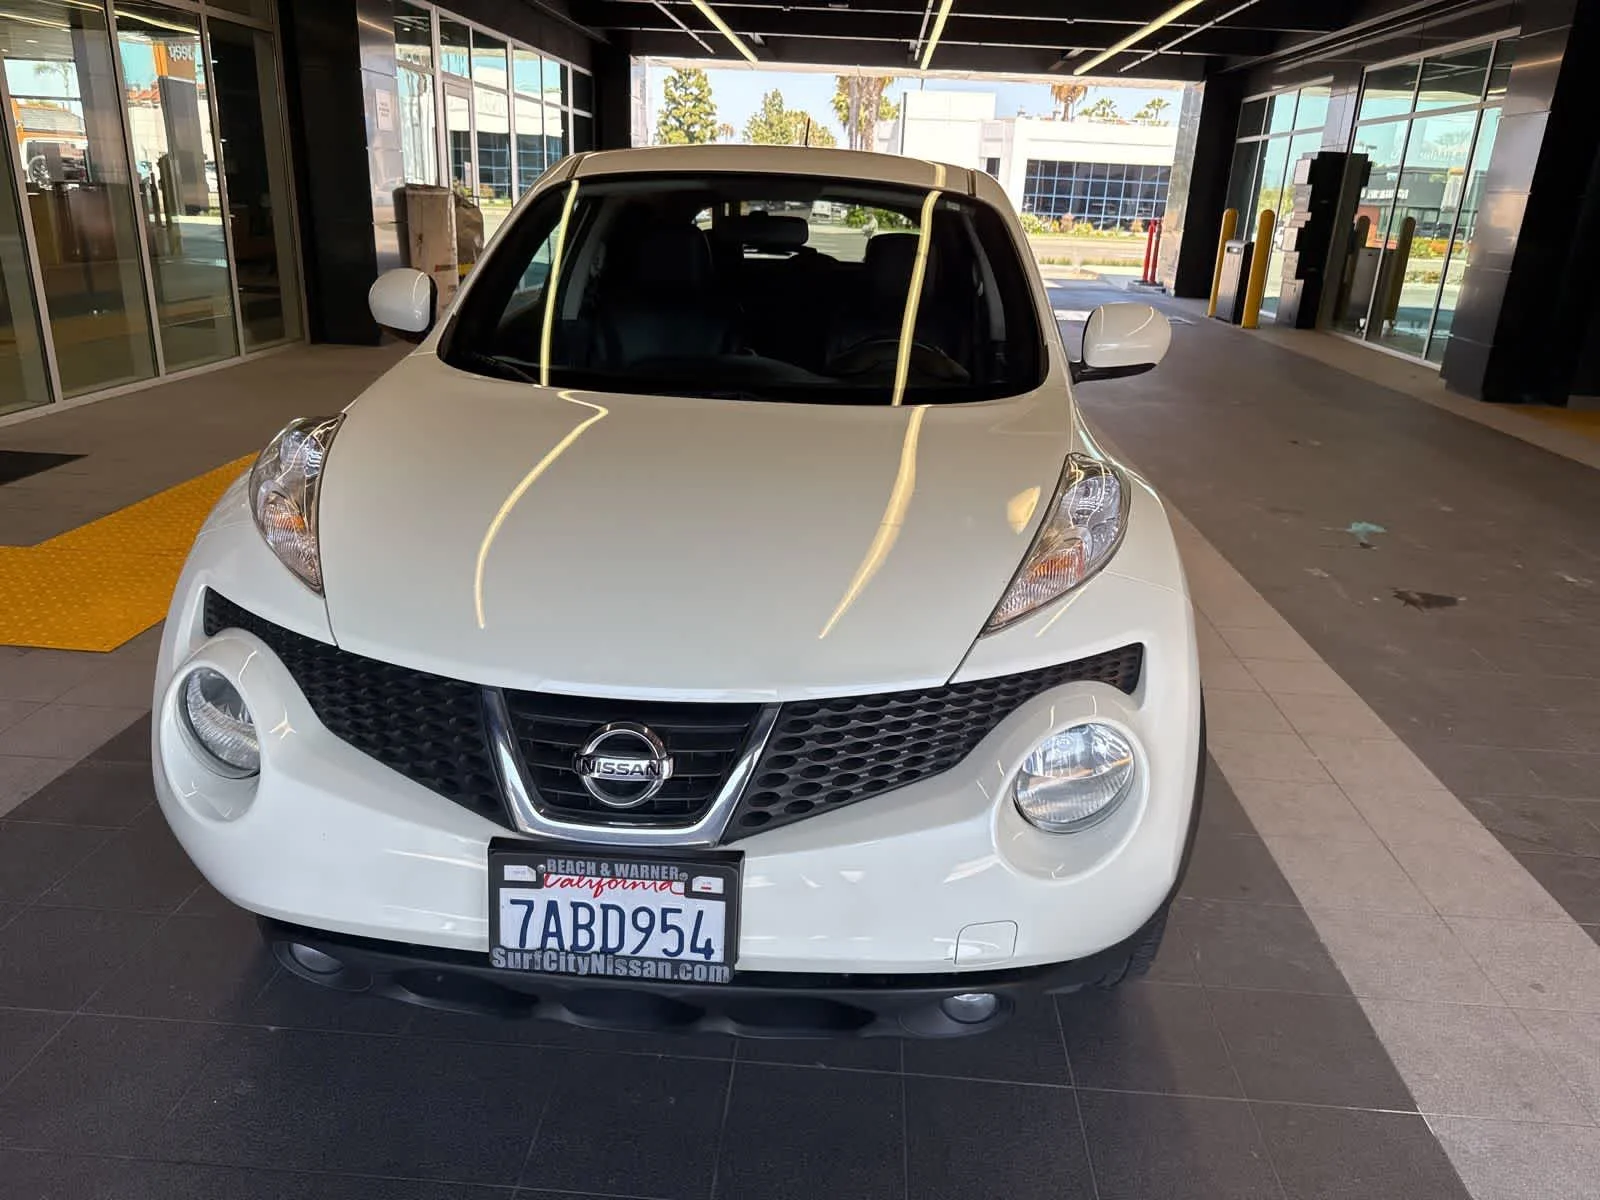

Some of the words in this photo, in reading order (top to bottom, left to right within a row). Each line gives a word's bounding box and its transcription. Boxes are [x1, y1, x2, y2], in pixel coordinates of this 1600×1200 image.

[580, 758, 660, 776] NISSAN
[547, 859, 597, 876] BEACH
[599, 864, 609, 877] &
[613, 863, 679, 881] WARNER
[543, 874, 685, 898] California
[510, 899, 714, 960] 7ABD954
[492, 948, 731, 983] SurfCityNissan.com
